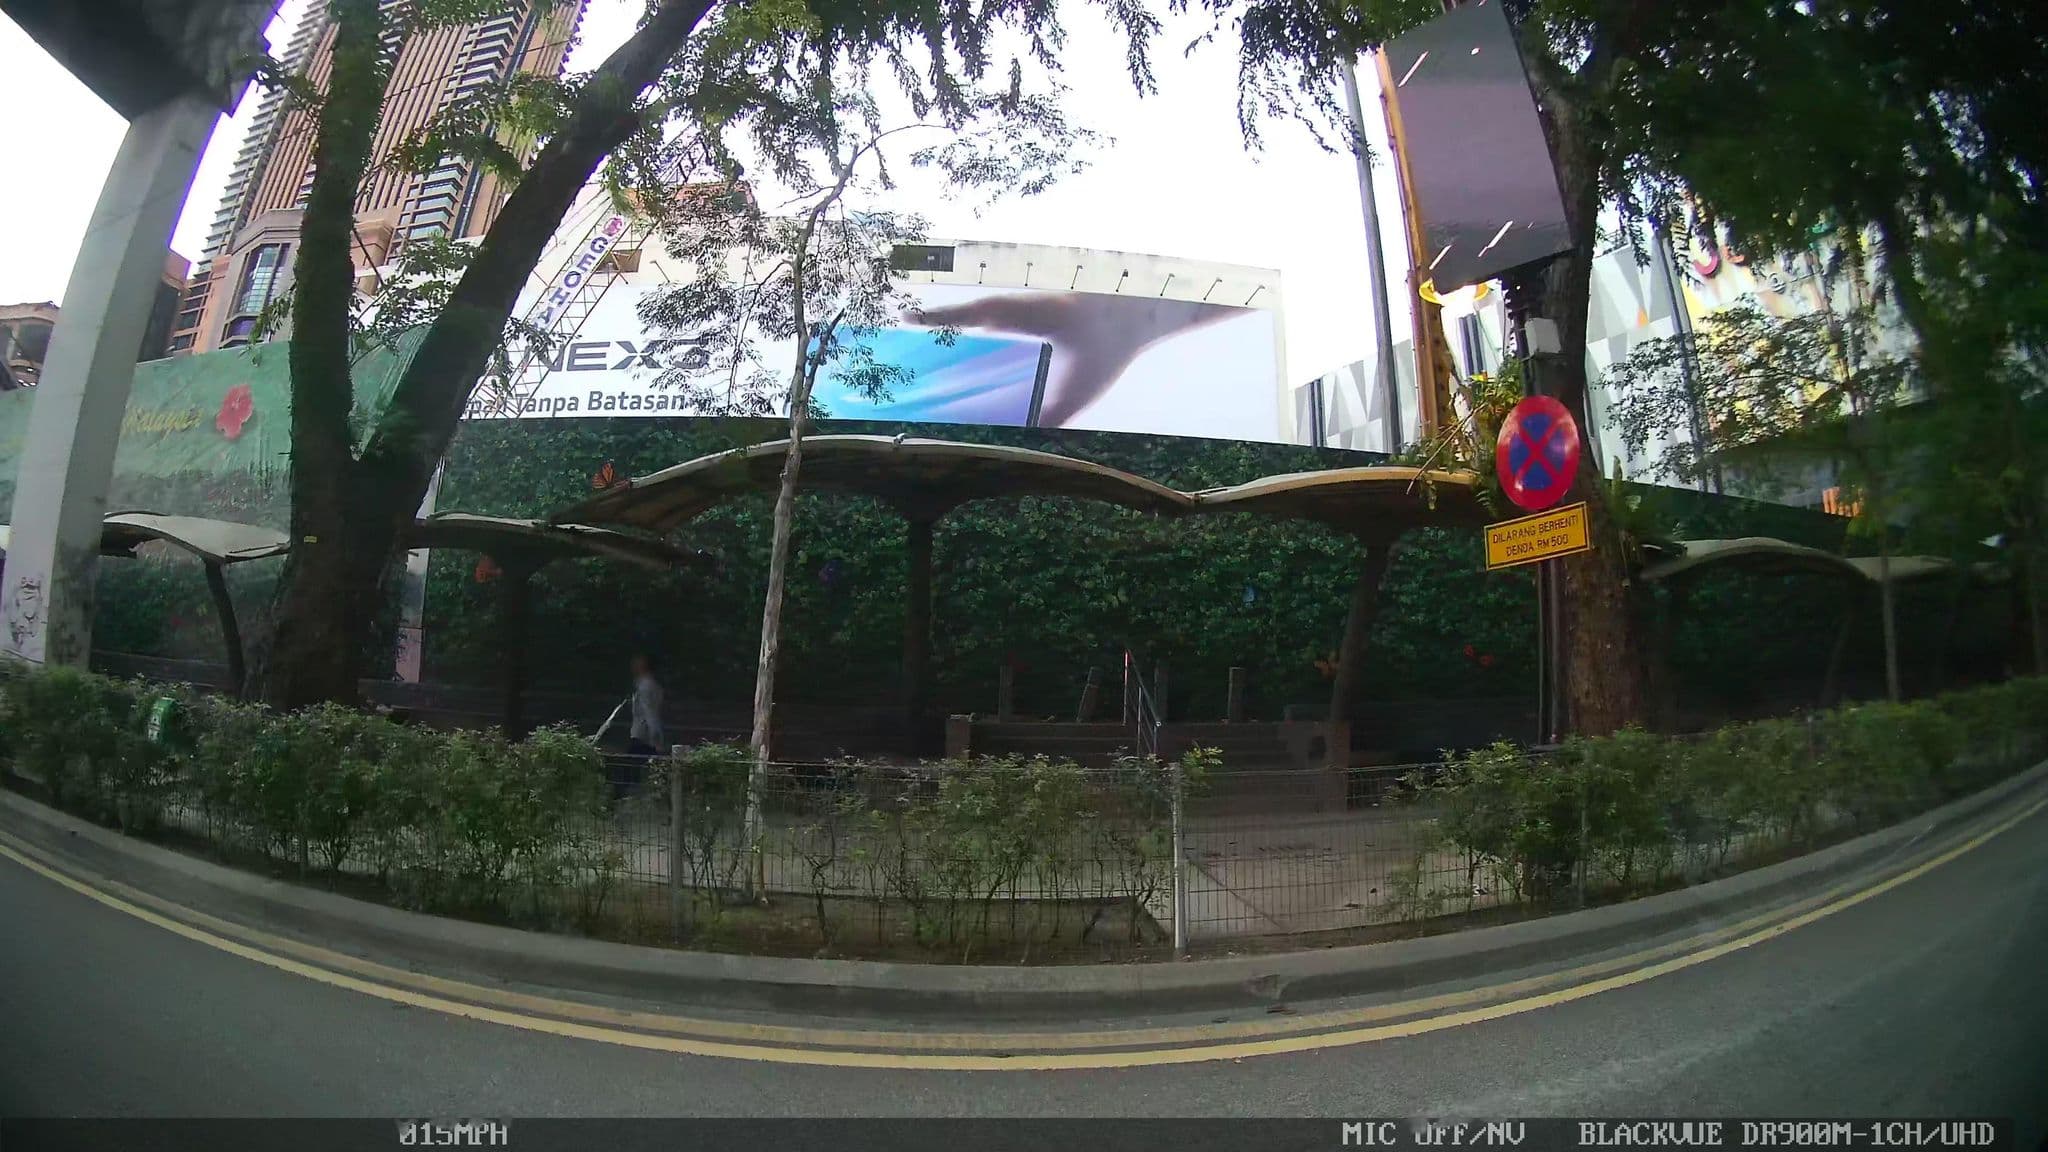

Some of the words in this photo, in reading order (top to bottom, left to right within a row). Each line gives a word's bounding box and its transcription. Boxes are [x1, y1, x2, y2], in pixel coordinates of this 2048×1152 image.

[587, 390, 685, 411] Batasan
[1493, 525, 1536, 544] DILARANG
[1538, 515, 1577, 533] BERHENTI
[1506, 542, 1535, 557] DENDA
